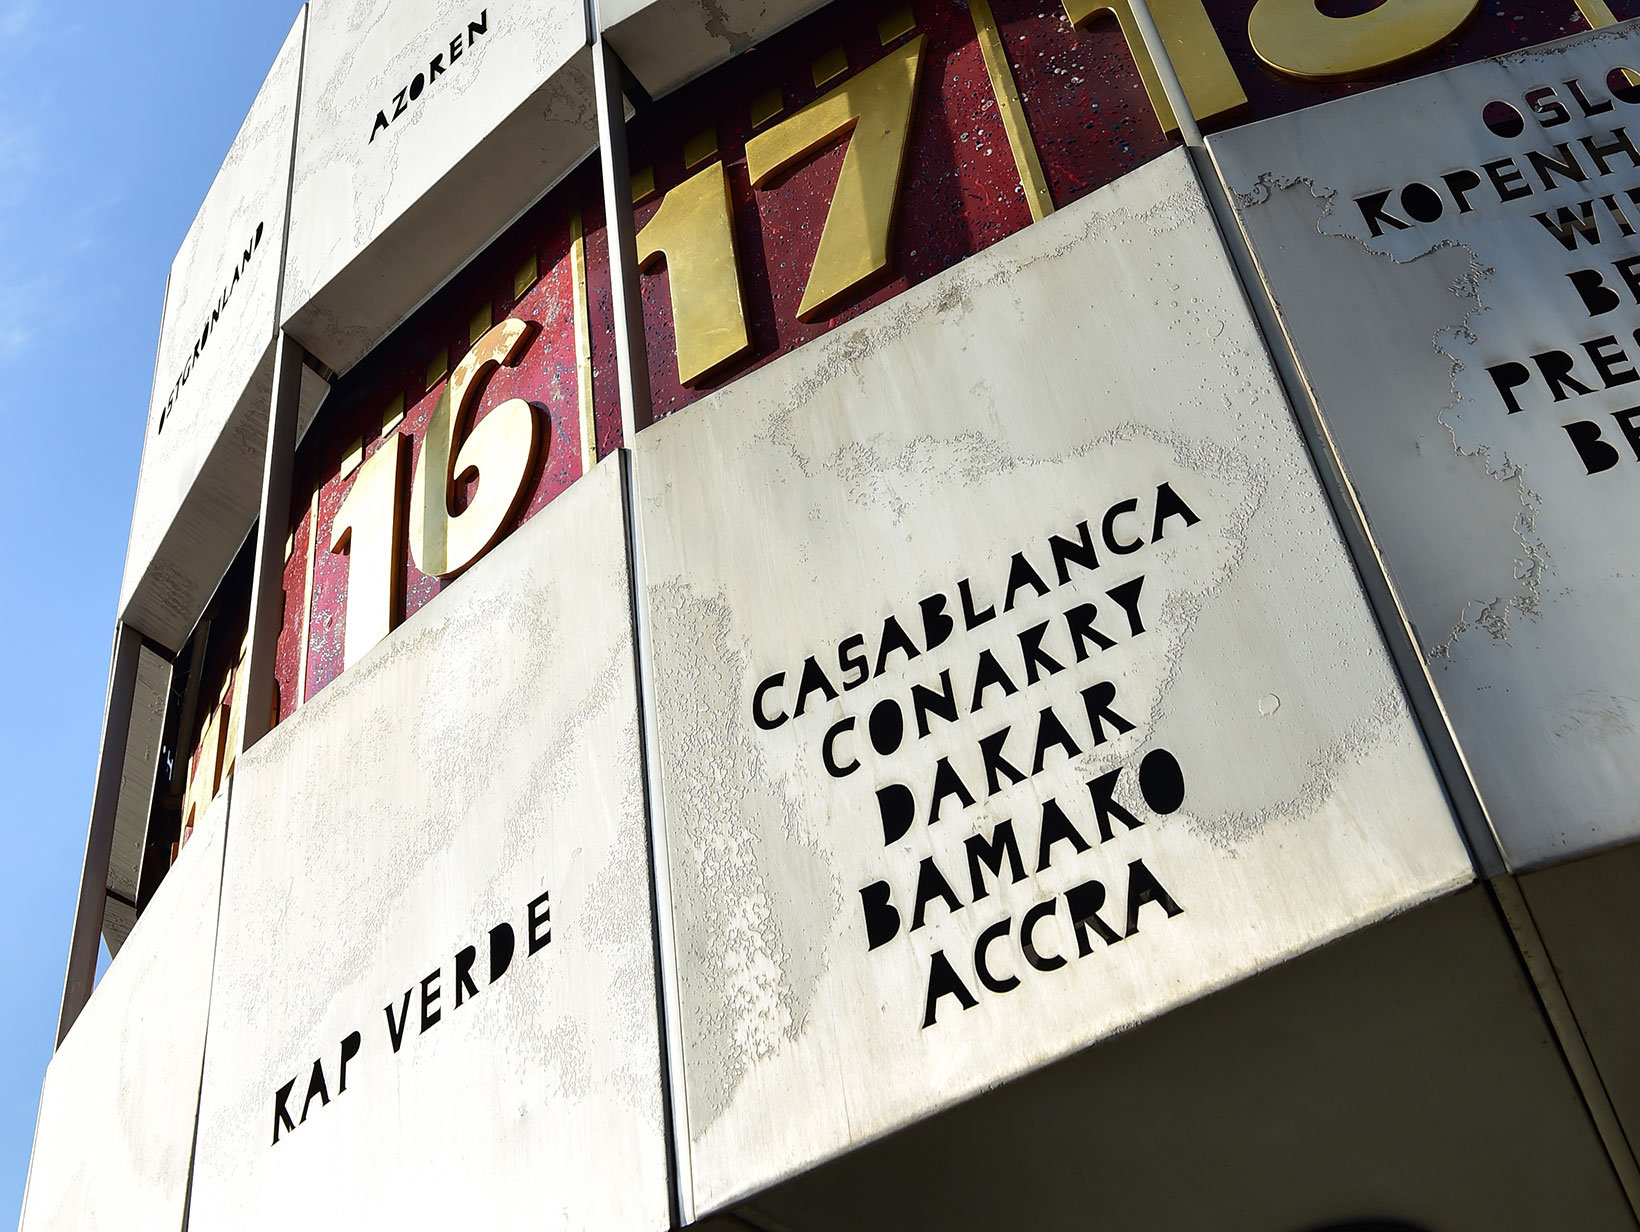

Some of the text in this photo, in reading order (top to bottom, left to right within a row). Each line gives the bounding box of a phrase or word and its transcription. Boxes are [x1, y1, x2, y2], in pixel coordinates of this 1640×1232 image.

[368, 8, 489, 145] AZOREN
[1482, 67, 1640, 139] OSLO
[635, 33, 928, 390] 17
[1352, 126, 1640, 239] KOPENH
[1484, 327, 1640, 416] PRE
[328, 317, 550, 674] 16
[751, 481, 1202, 732] CASABLANCA
[821, 574, 1147, 779] CONAKRY
[858, 747, 1186, 953] BAMAKO
[874, 680, 1137, 848] DAKAR
[270, 890, 553, 1148] KAP VERDE
[921, 858, 1186, 1031] ACCRA
